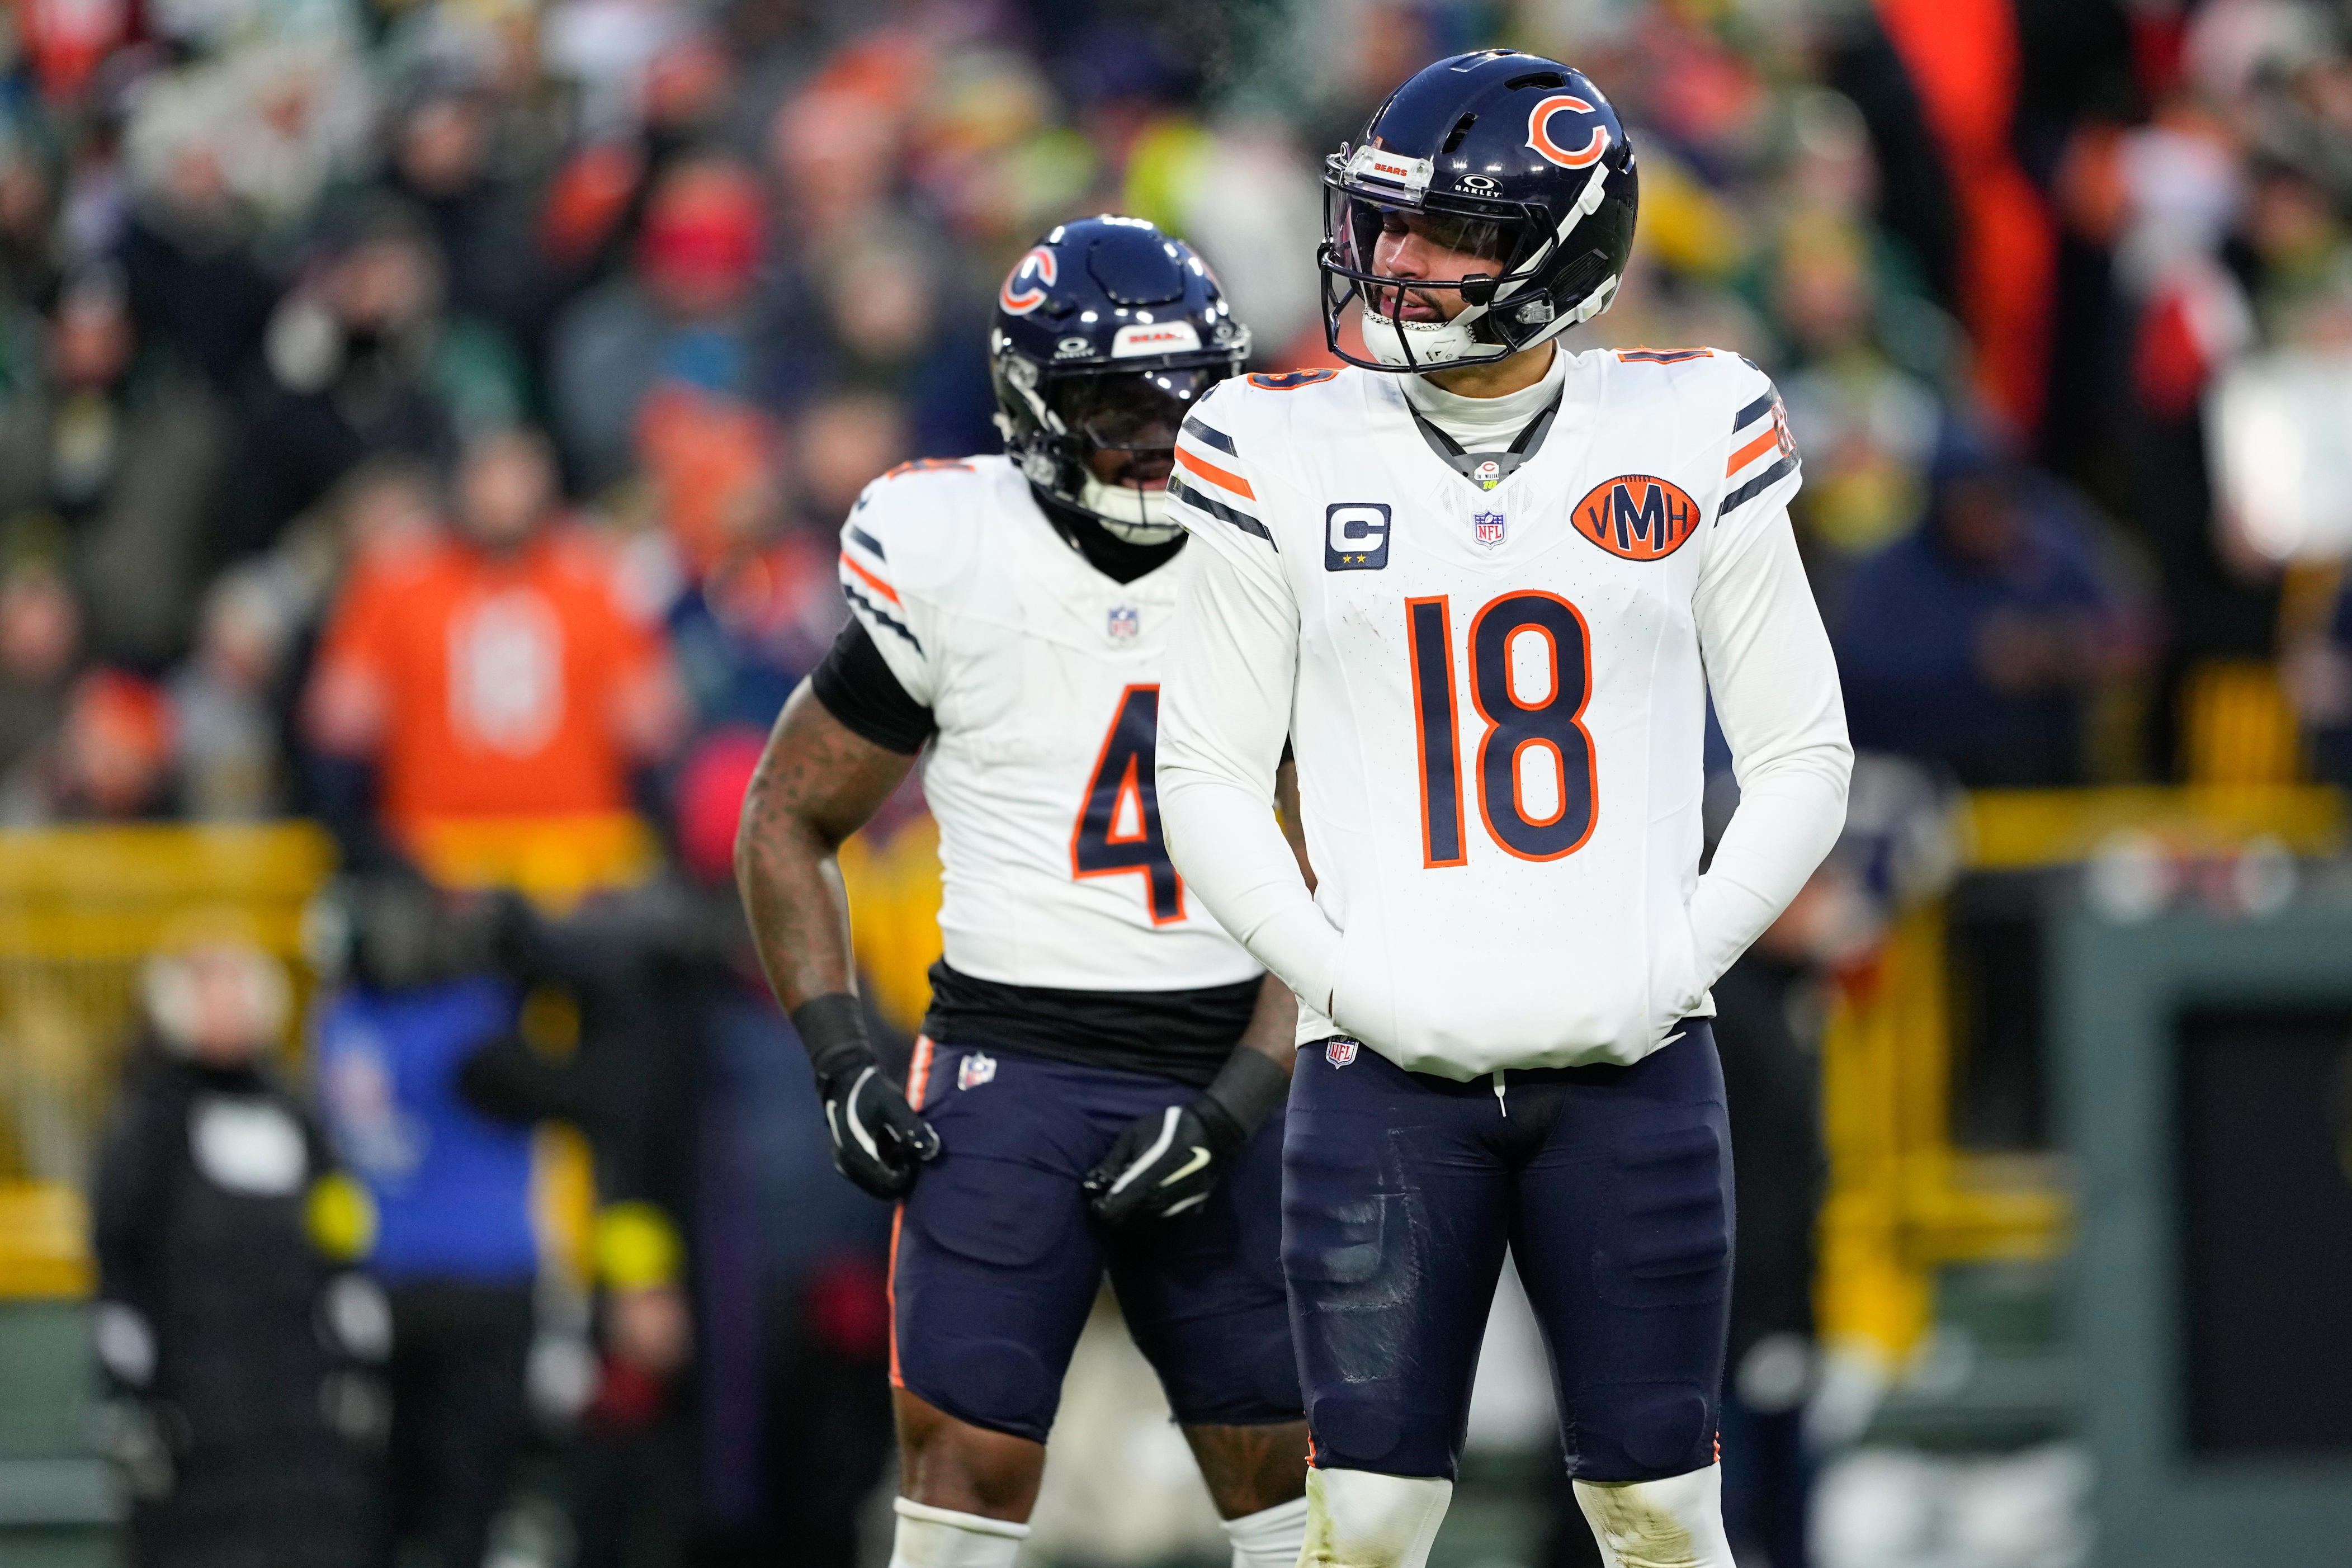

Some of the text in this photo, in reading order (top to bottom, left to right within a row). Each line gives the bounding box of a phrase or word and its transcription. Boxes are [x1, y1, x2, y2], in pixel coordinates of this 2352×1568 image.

[1524, 95, 1607, 169] C
[1374, 163, 1408, 177] BEARS
[1455, 185, 1501, 197] OAKLEY
[1483, 480, 1498, 489] 18
[1330, 508, 1385, 552] C
[1588, 482, 1688, 553] VMH
[1478, 526, 1501, 541] NFL
[1404, 589, 1600, 869] 18
[1070, 683, 1188, 927] 4
[1330, 1043, 1350, 1061] NFL
